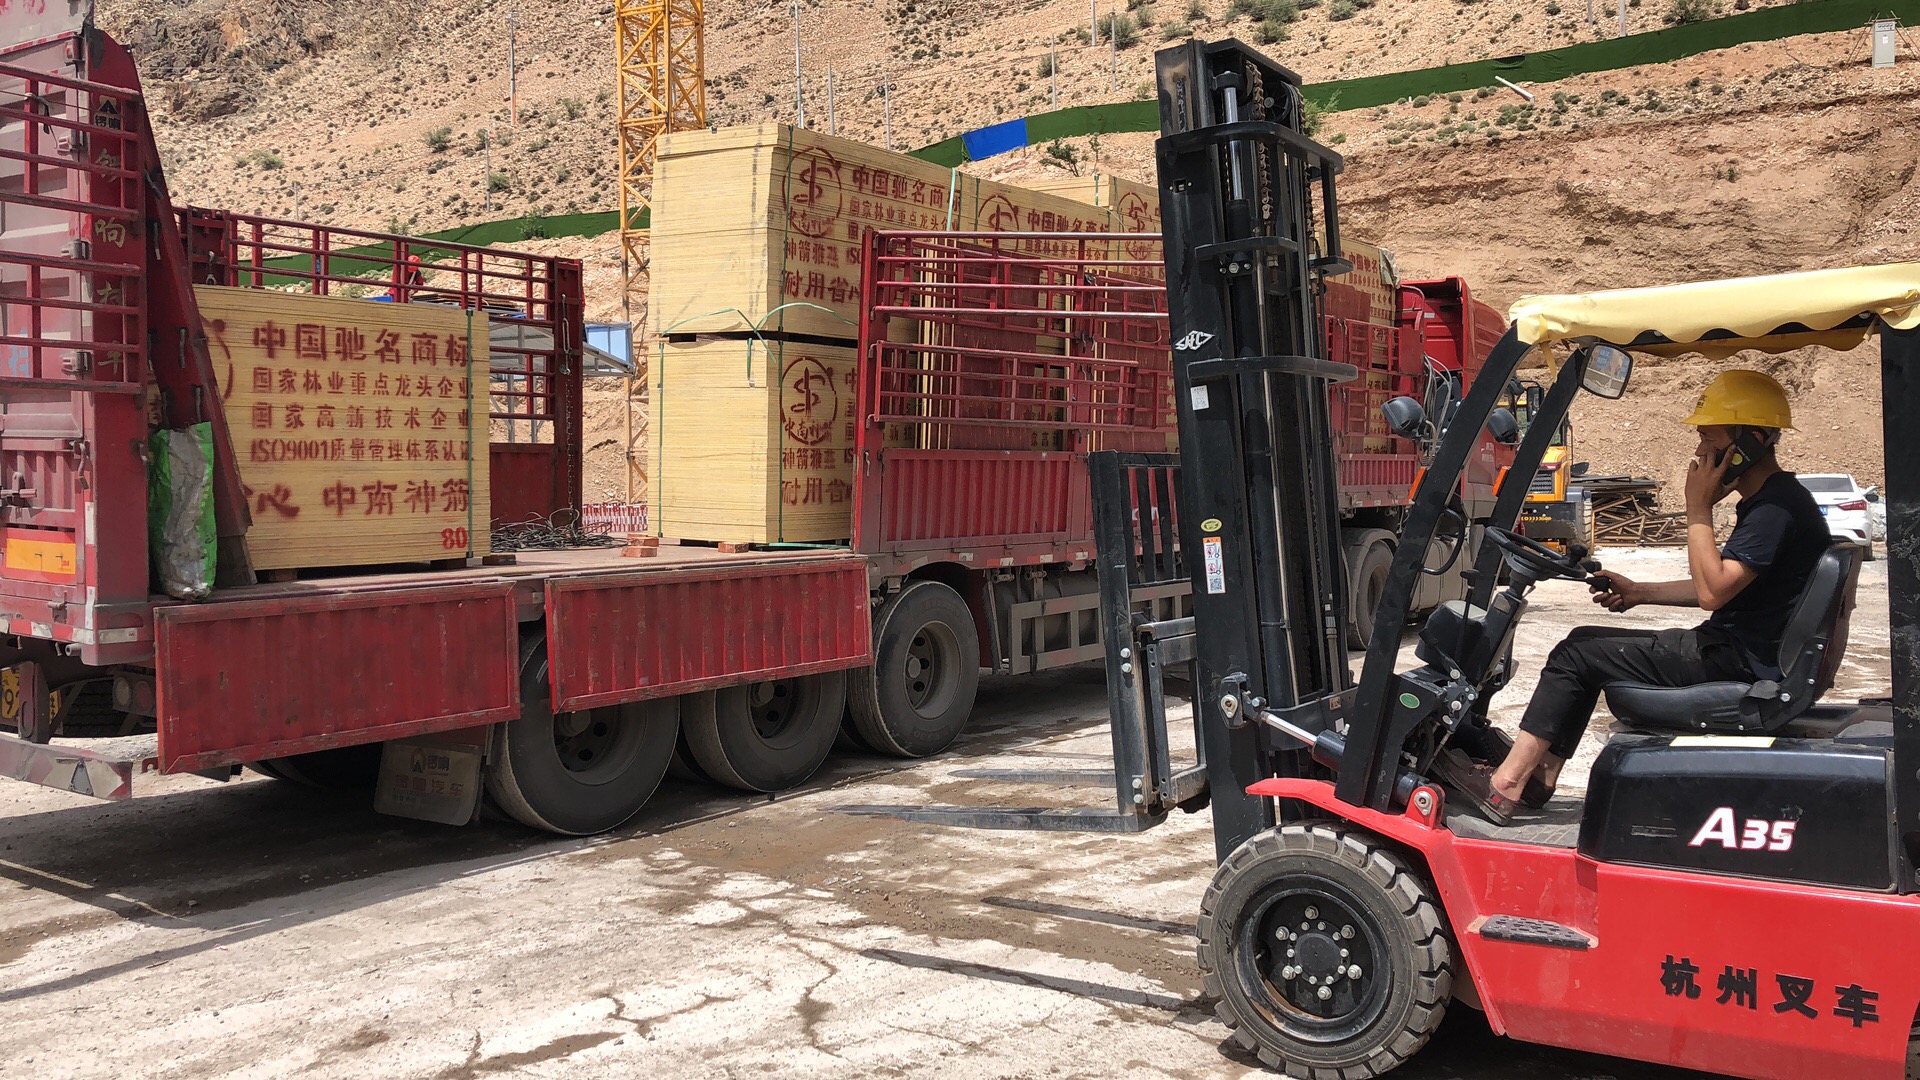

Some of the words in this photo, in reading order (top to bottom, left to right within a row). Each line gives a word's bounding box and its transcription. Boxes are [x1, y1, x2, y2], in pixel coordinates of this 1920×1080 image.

[851, 164, 962, 212] 中国驰名商标
[253, 320, 474, 368] 中国驰名商标
[252, 366, 474, 399] 国家林业重点龙头企业
[252, 402, 472, 430] 国家高新技术企业
[322, 477, 470, 518] 中南神箭
[440, 526, 469, 551] 80
[1688, 806, 1797, 851] A35
[1660, 954, 1880, 1028] 杭州叉车
